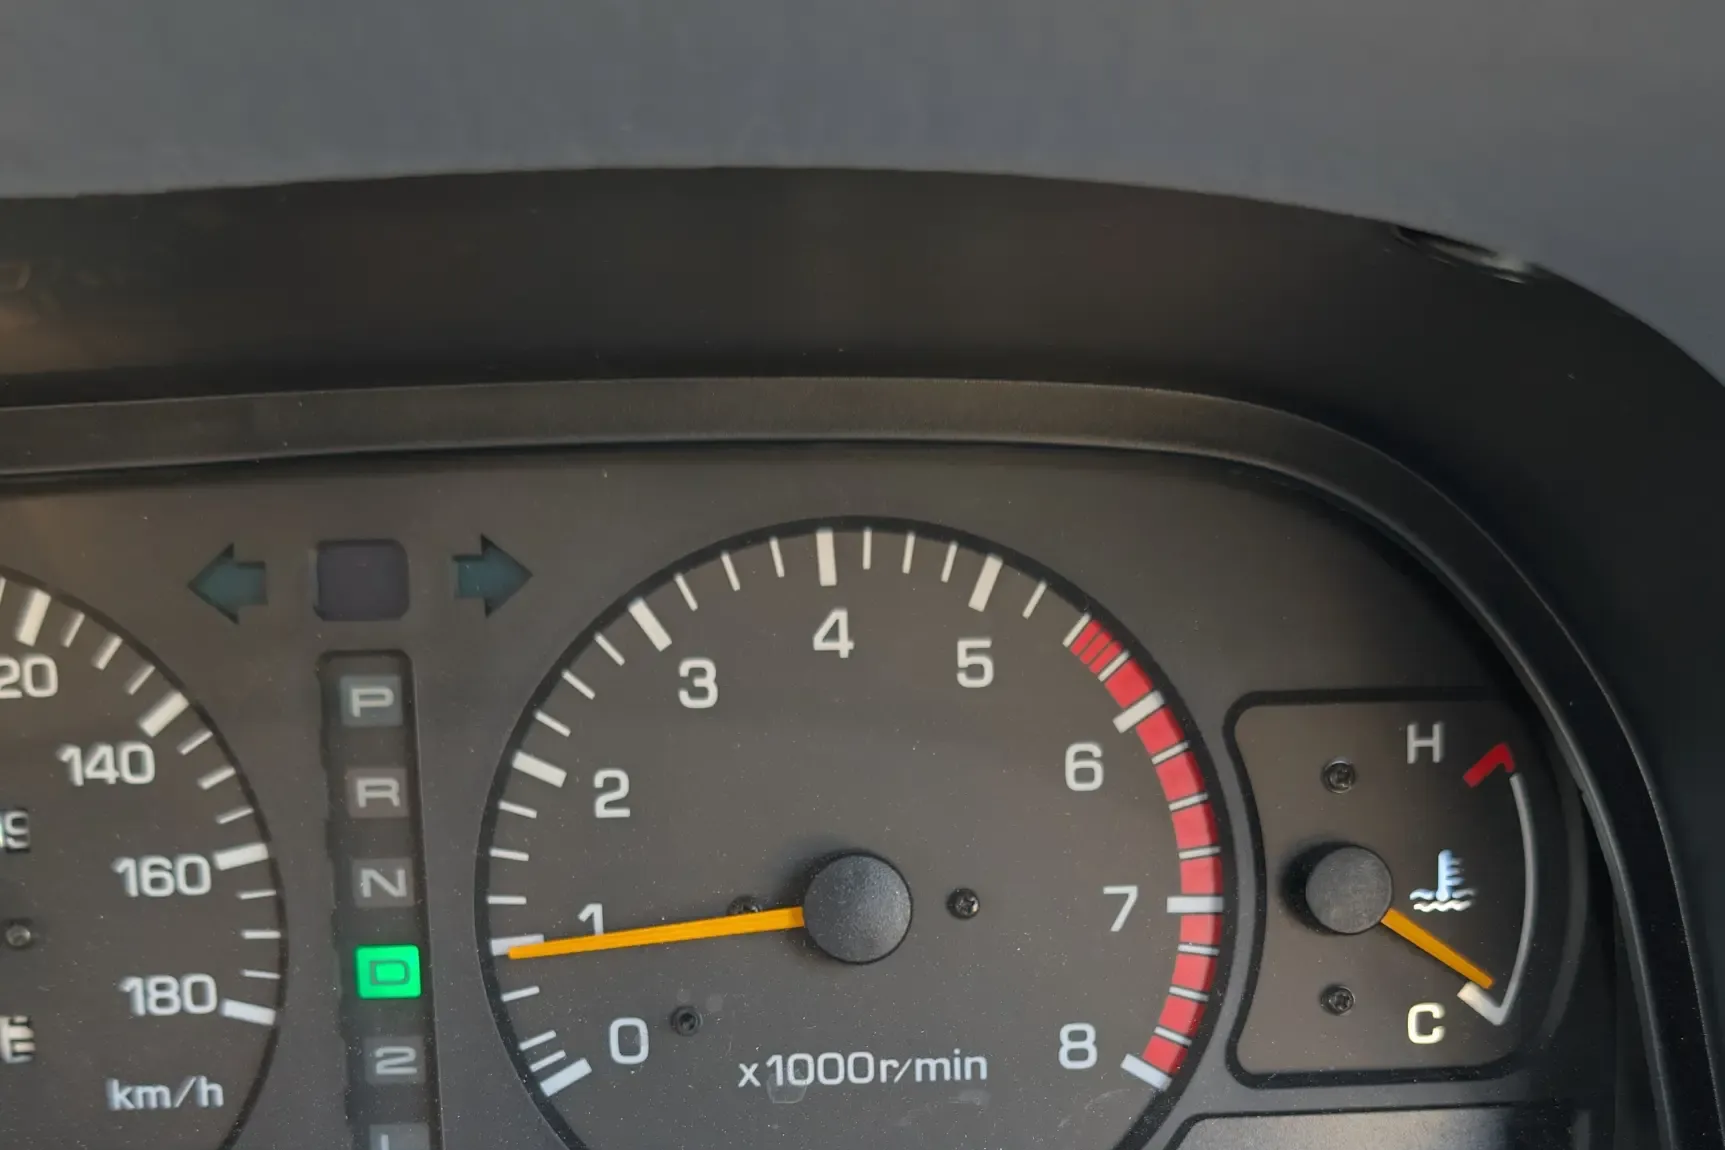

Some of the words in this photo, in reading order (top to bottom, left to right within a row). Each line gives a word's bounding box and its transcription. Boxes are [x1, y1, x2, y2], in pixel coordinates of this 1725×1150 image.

[813, 608, 855, 659] 4
[678, 658, 719, 709] 3
[956, 638, 995, 688] 5
[350, 686, 395, 719] P
[59, 742, 156, 787] 140
[1406, 723, 1443, 764] H
[1065, 742, 1104, 792] 6
[356, 776, 401, 808] R
[593, 769, 632, 819] 2
[114, 854, 212, 897] 160
[360, 868, 408, 899] N
[577, 902, 604, 936] 1
[1103, 885, 1139, 932] 7
[369, 957, 410, 985] D
[120, 973, 218, 1016] 180
[609, 1017, 650, 1065] 0
[1407, 1002, 1445, 1045] C
[374, 1045, 418, 1076] 2
[1058, 1022, 1099, 1070] 8
[108, 1074, 225, 1112] km/h
